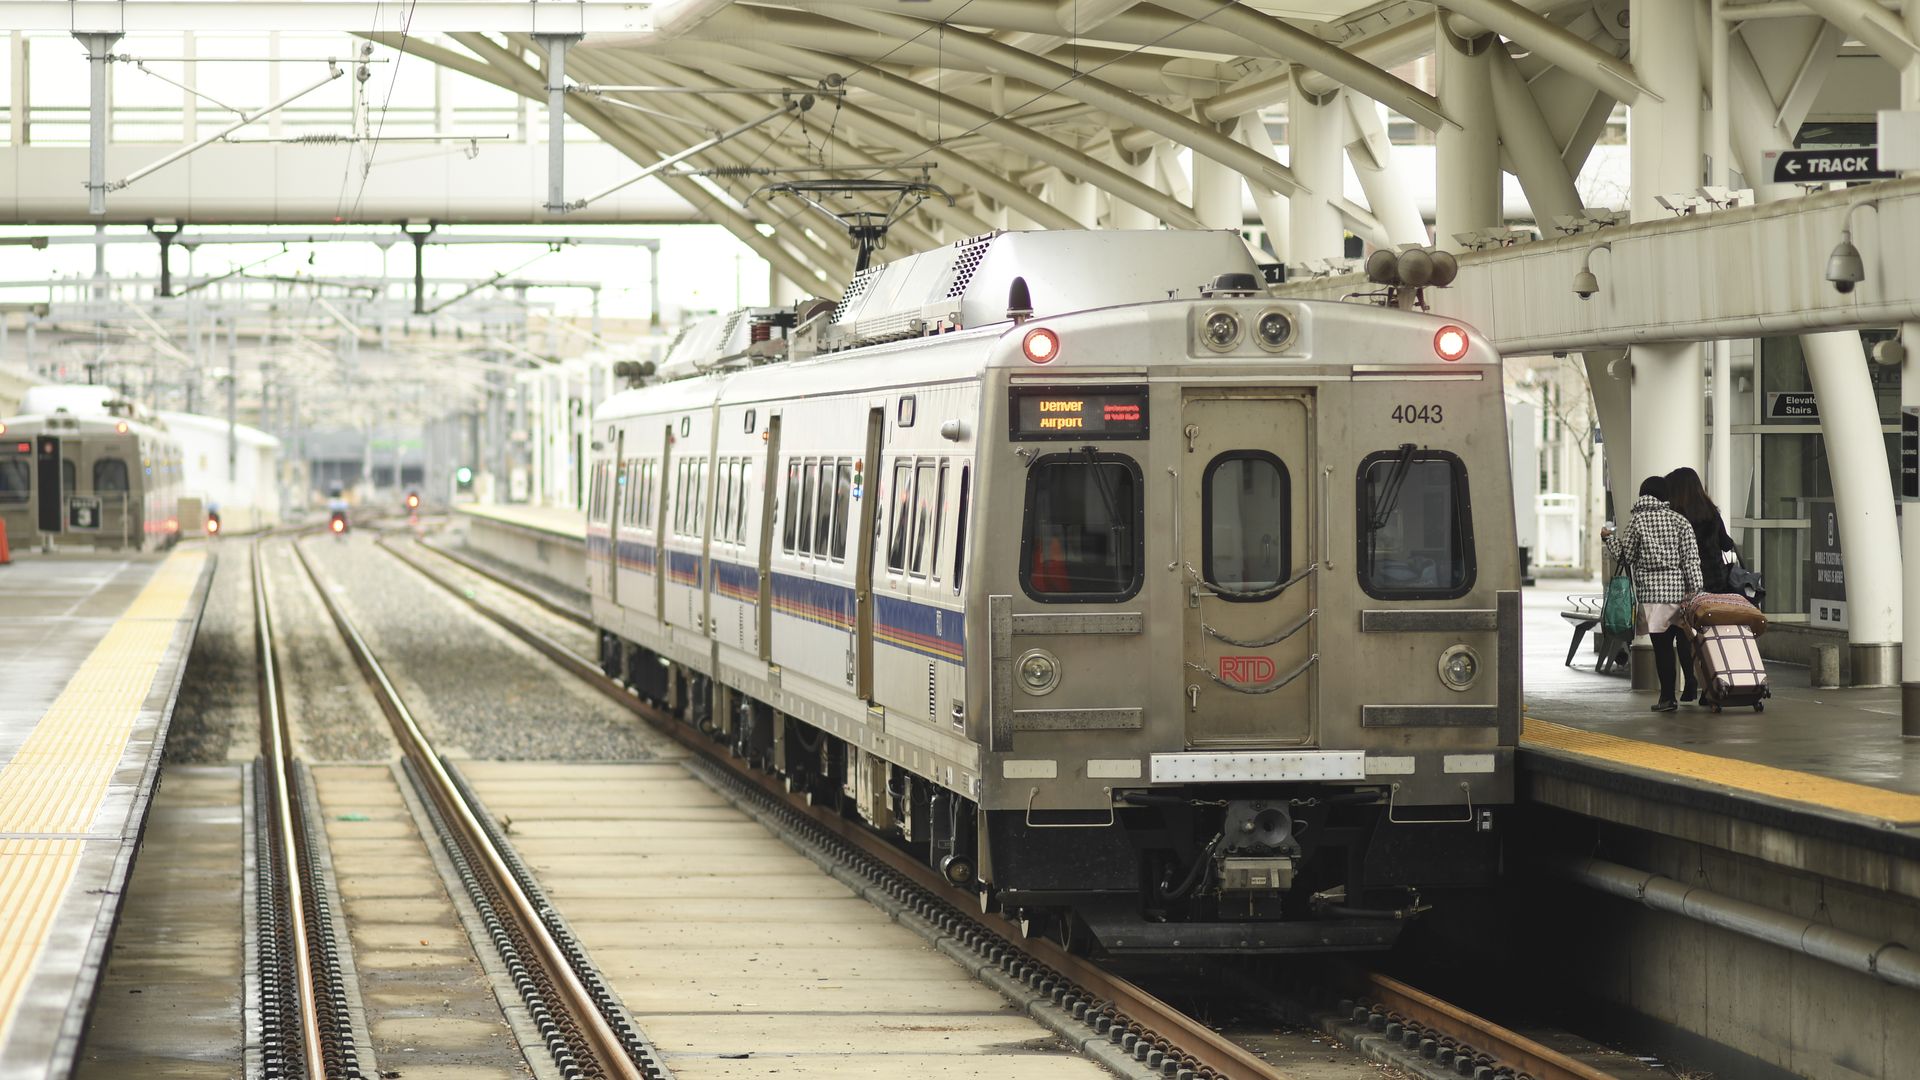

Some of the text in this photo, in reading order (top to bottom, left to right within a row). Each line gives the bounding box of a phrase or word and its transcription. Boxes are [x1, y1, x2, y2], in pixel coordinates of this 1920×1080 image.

[1807, 157, 1870, 173] TRACK
[1273, 267, 1280, 280] 1
[1039, 400, 1084, 412] Denver
[1785, 406, 1812, 414] Stairs
[1391, 404, 1443, 424] 4043
[1039, 417, 1083, 430] Airport
[78, 508, 92, 527] 3
[1219, 655, 1276, 683] RTD
